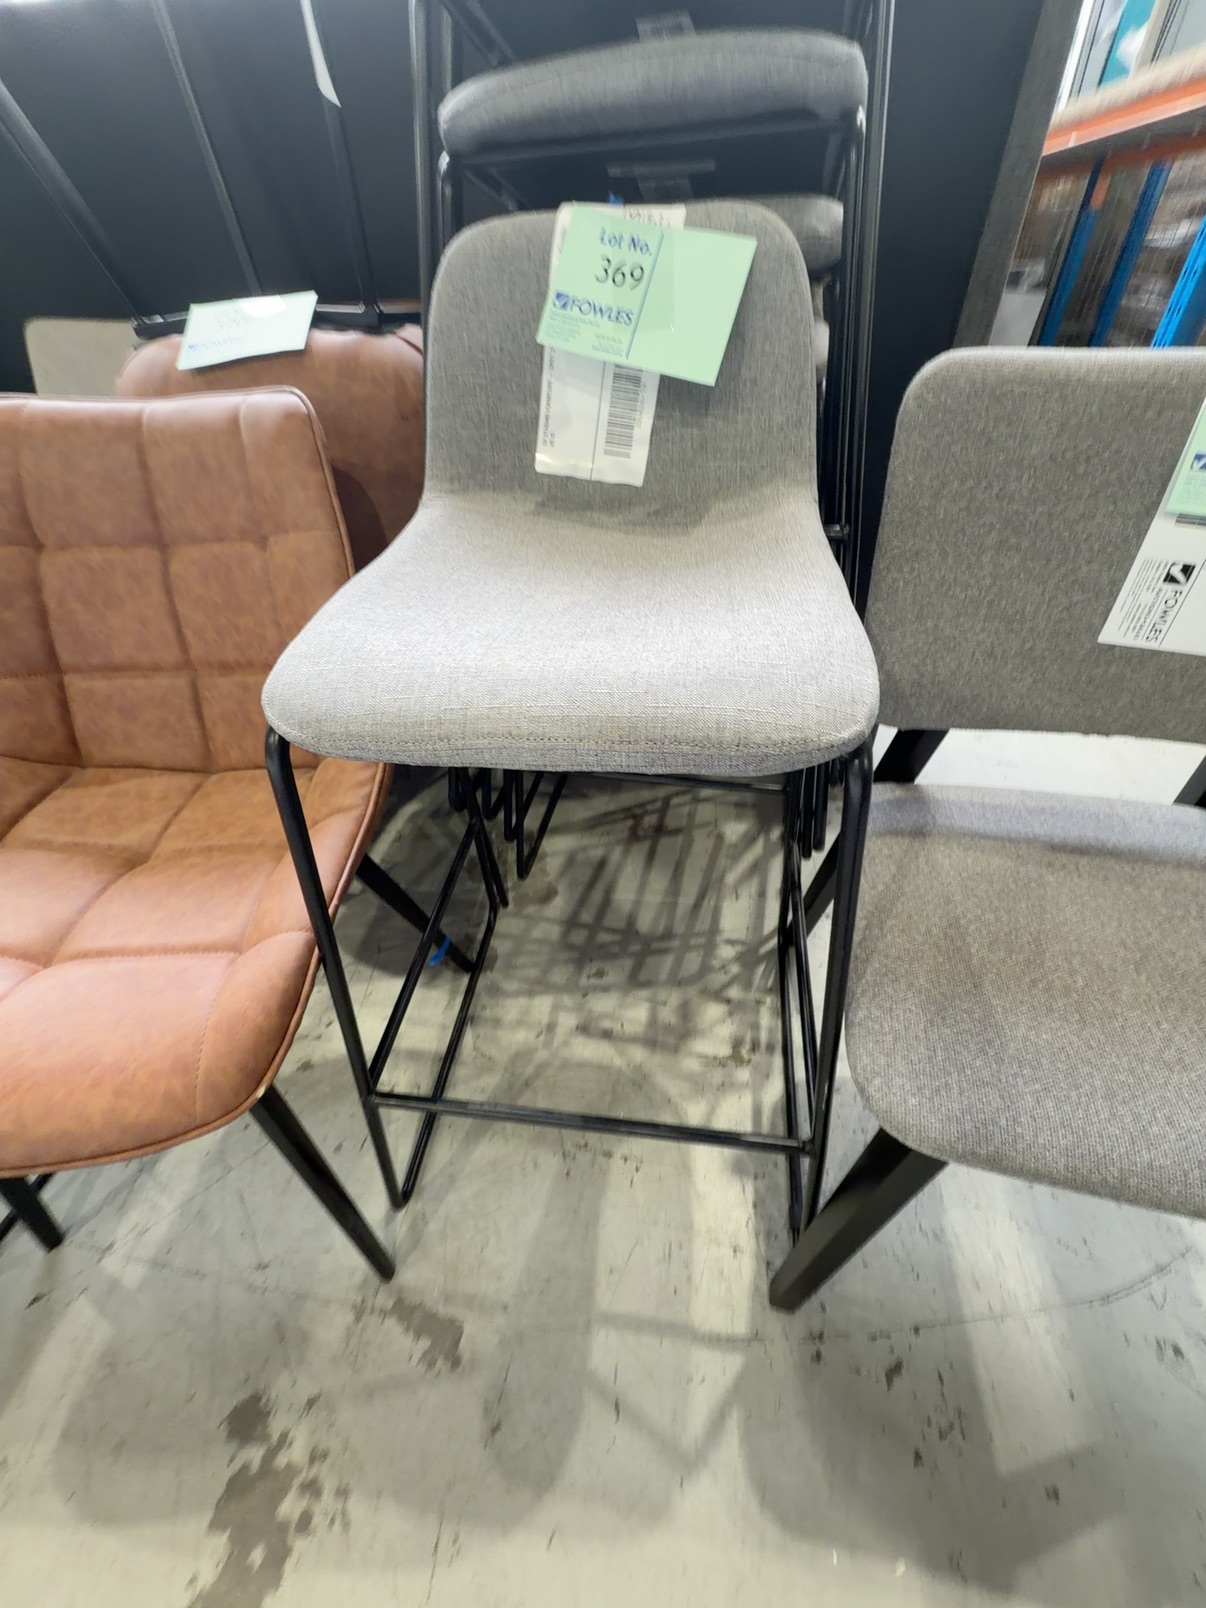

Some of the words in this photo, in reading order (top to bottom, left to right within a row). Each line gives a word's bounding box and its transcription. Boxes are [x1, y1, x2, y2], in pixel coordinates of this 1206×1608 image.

[599, 227, 624, 249] Lot
[627, 236, 653, 256] No.
[594, 254, 645, 291] 369
[569, 298, 634, 327] FOWLES
[1145, 590, 1183, 643] FOWLES
